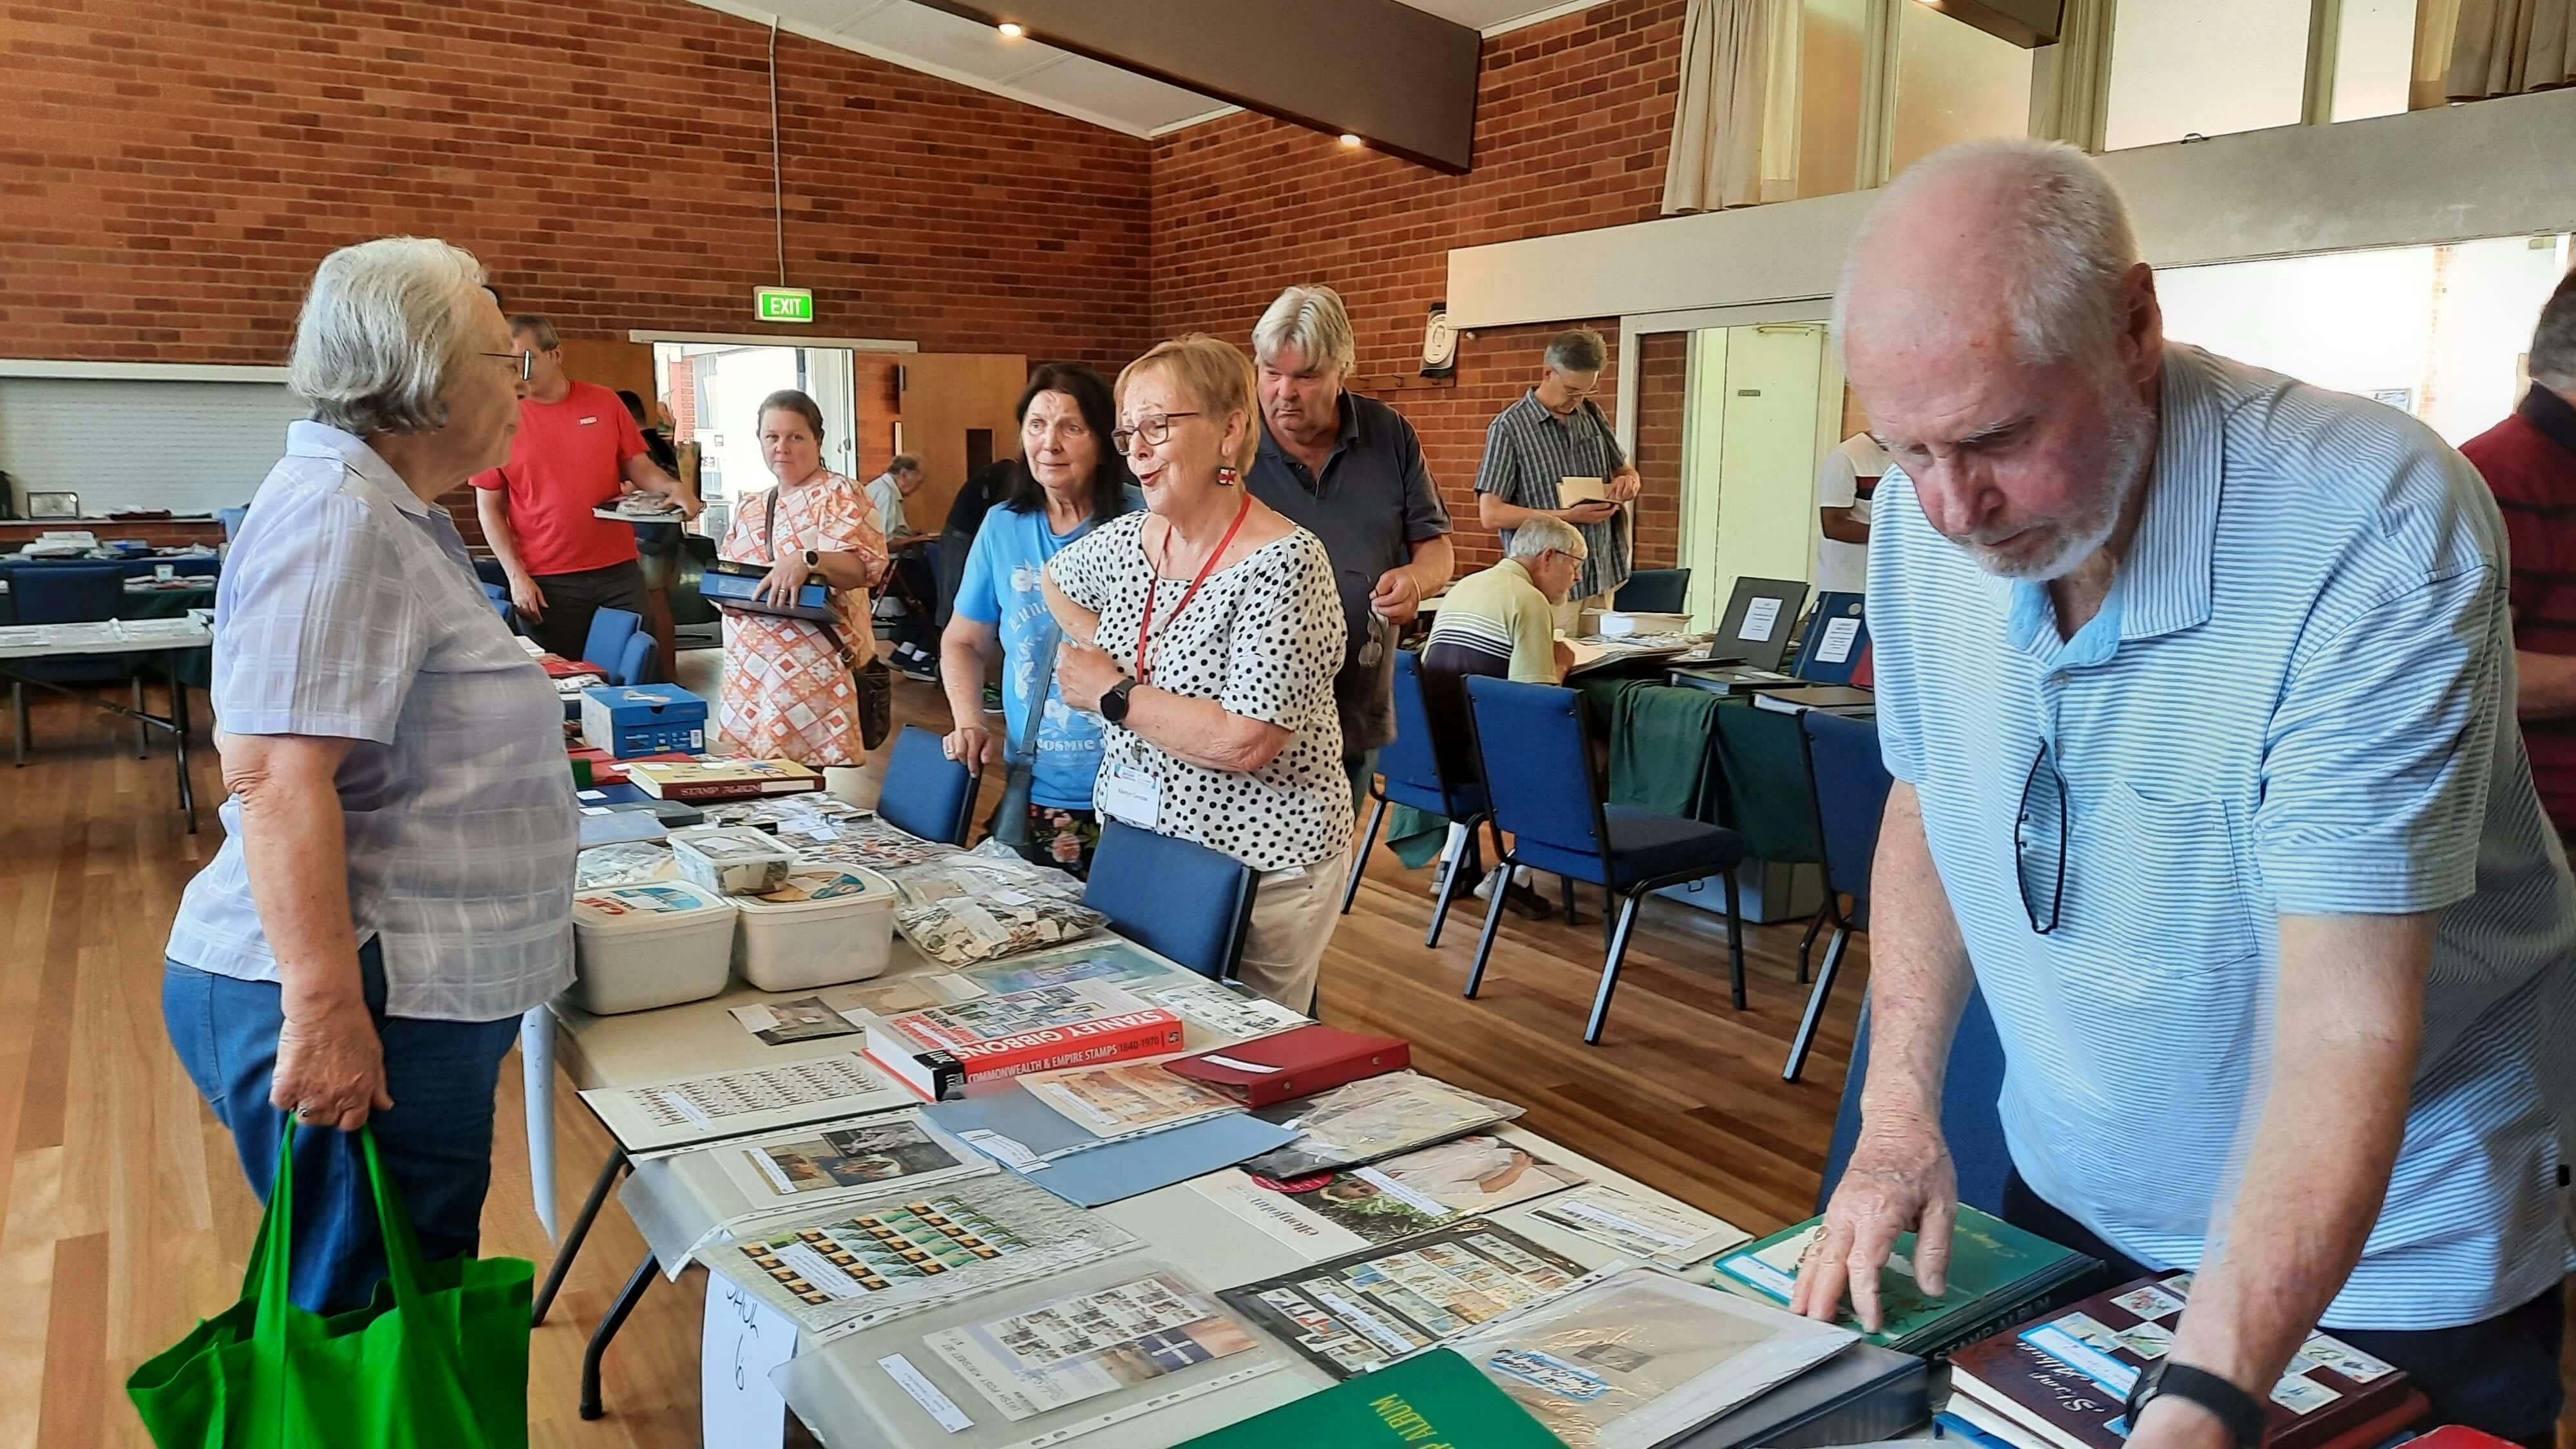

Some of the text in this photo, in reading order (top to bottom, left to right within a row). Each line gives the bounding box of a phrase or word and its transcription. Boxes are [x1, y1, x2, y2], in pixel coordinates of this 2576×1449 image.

[770, 297, 802, 315] EXIT
[1036, 738, 1094, 752] COSMIC
[1066, 1011, 1164, 1037] STANLEY
[951, 1030, 1064, 1061] GIBBONS
[967, 1061, 1042, 1084] COMMONWEALTH
[1044, 1058, 1051, 1068] &
[1052, 1051, 1083, 1067] EMPIRE
[1085, 1044, 1117, 1061] STAMPS
[1368, 1392, 1438, 1441] ALBUM
